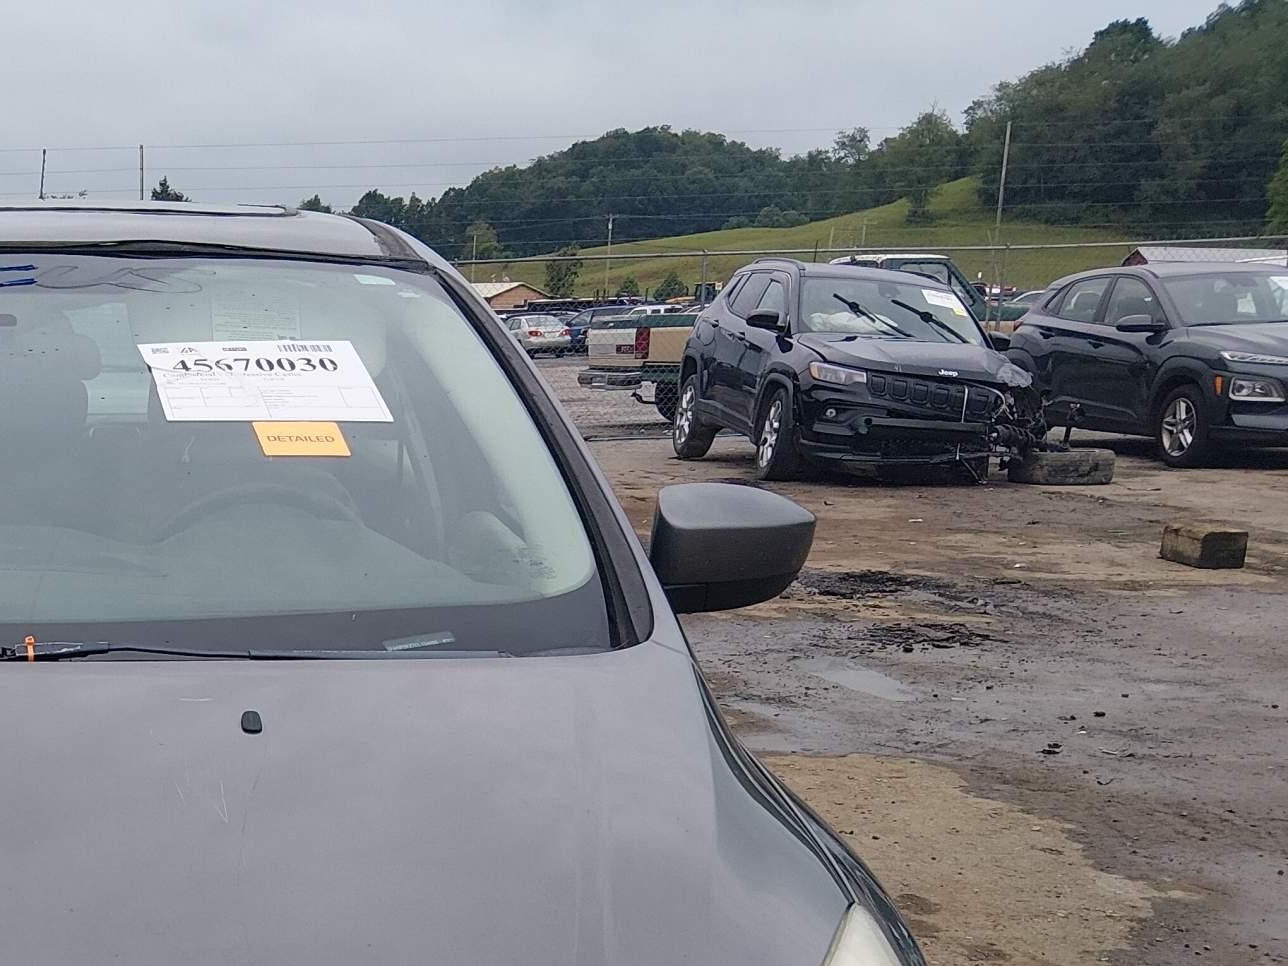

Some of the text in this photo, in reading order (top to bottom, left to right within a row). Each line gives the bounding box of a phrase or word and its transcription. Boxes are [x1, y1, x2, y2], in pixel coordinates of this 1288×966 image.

[172, 357, 339, 373] 45670030
[938, 369, 958, 377] Jeep
[266, 435, 335, 443] DETAILED
